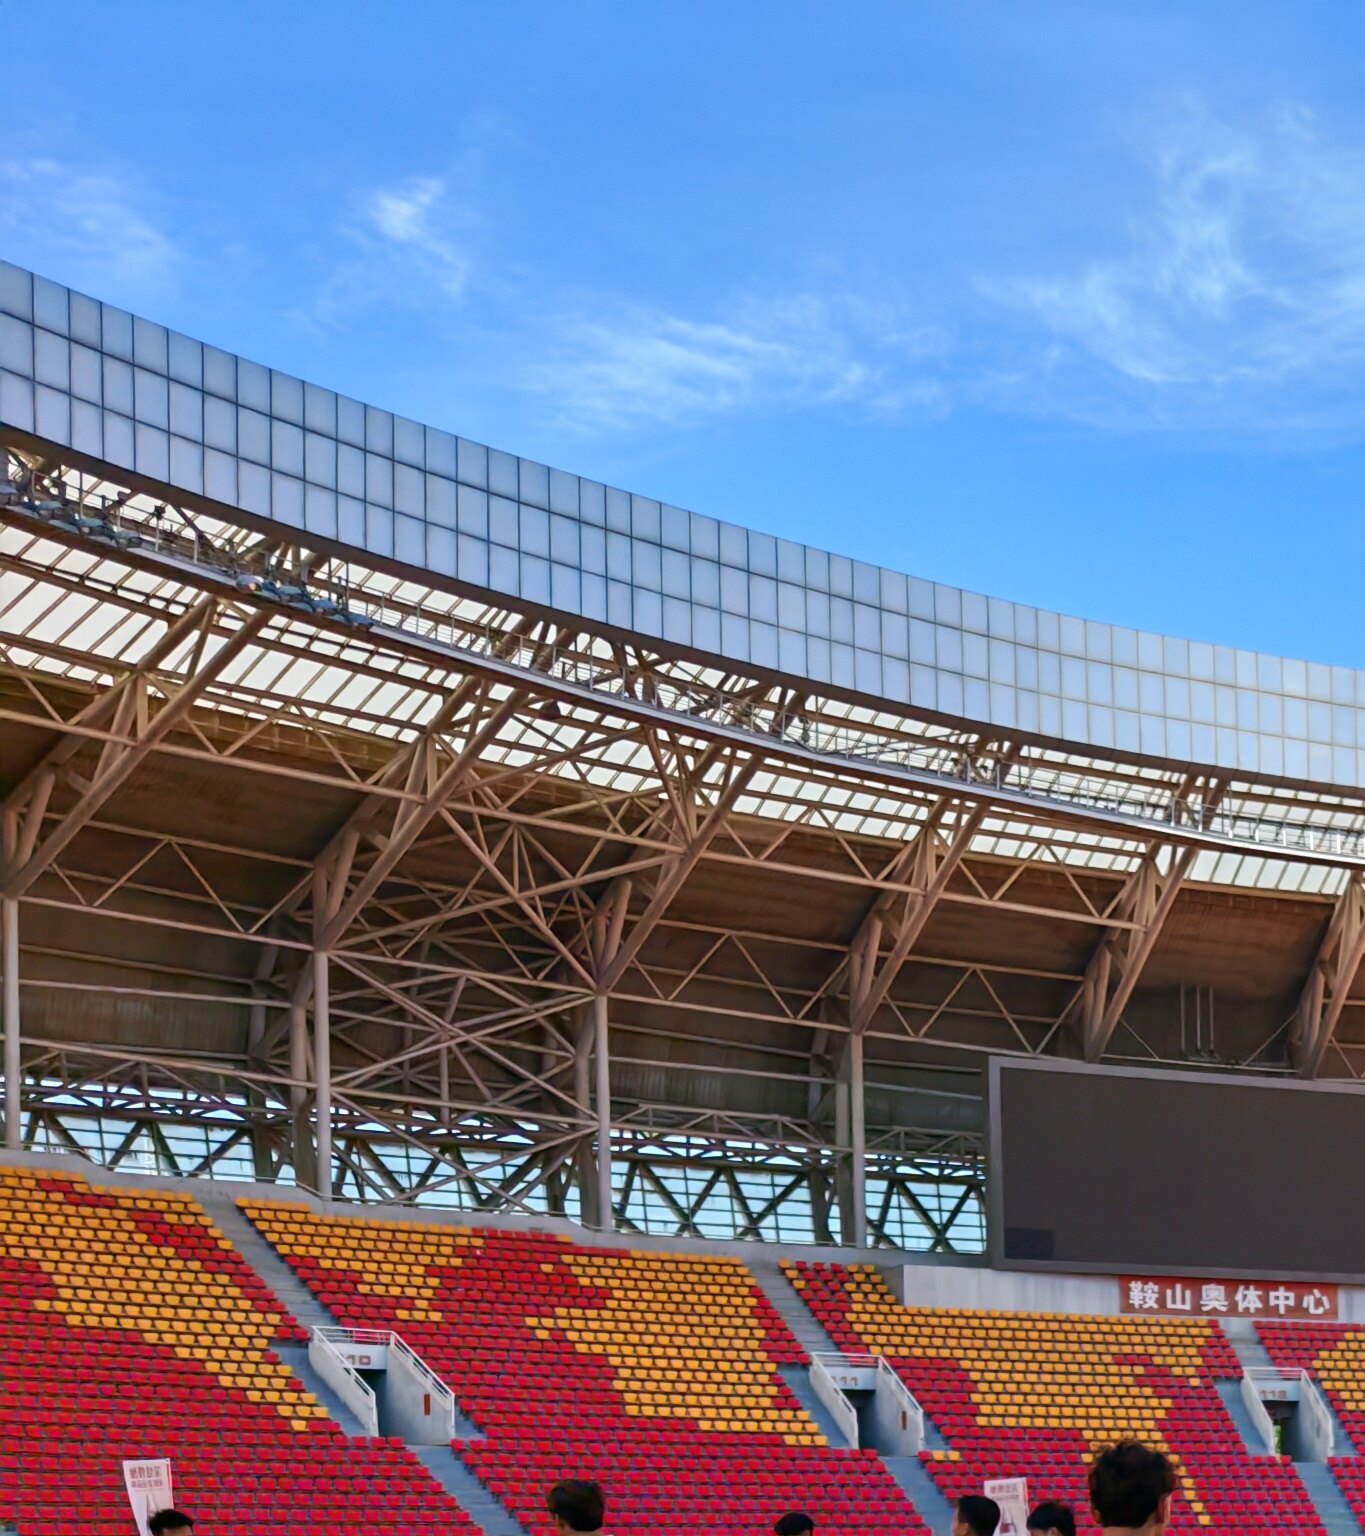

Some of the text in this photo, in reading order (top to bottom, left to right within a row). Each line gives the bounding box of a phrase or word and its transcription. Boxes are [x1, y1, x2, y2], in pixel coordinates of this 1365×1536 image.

[1127, 1280, 1331, 1315] 鞍山奥体中心
